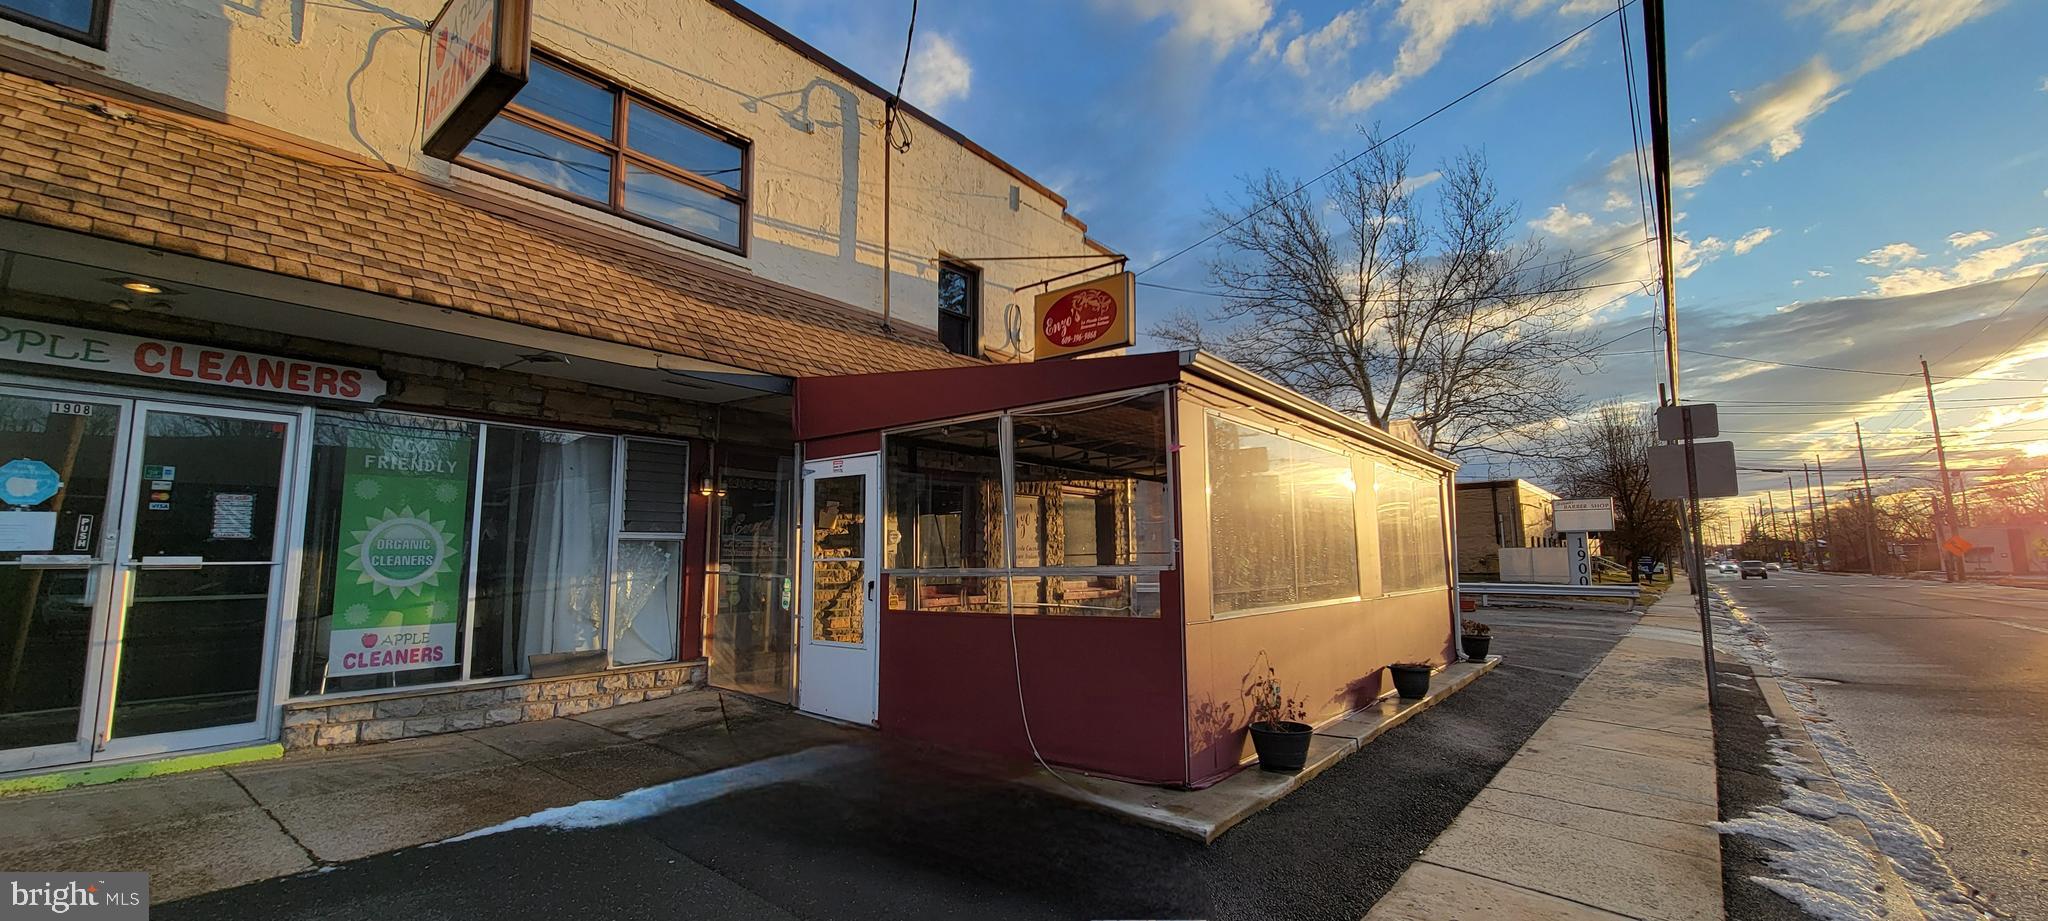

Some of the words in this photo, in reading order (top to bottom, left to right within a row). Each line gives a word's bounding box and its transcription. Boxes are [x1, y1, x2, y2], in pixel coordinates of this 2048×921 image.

[426, 8, 493, 129] CLEANERS
[1045, 308, 1080, 337] Enzo's
[134, 342, 362, 398] CLEANERS
[54, 402, 91, 415] 1908
[364, 454, 457, 474] FRIENDLY
[77, 517, 90, 547] PUSH
[377, 538, 431, 551] ORGANIC
[371, 554, 433, 567] CLEANERS
[1577, 537, 1589, 586] 1900
[381, 632, 430, 646] APPLE
[343, 646, 444, 670] CLEANERS
